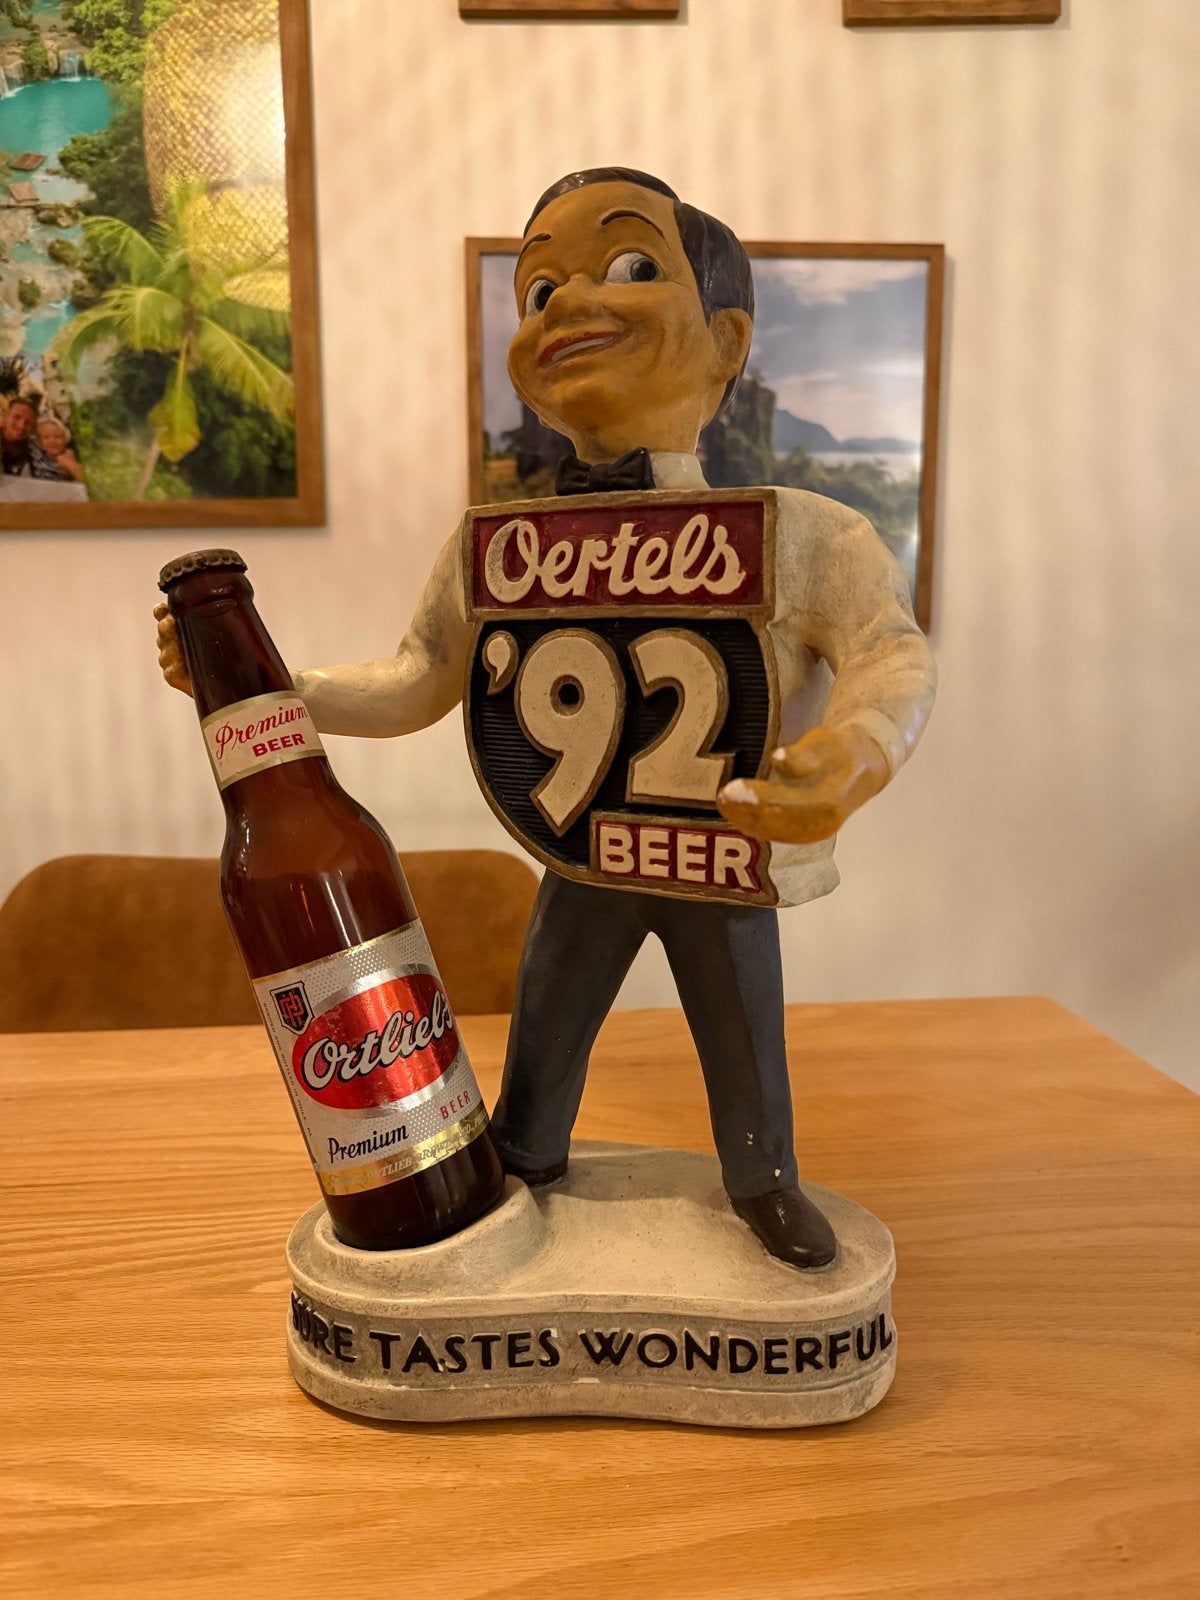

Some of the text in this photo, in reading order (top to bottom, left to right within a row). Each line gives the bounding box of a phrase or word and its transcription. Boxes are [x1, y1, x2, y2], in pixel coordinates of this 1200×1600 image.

[215, 706, 308, 760] Premium
[252, 733, 306, 758] BEER
[482, 628, 735, 837] '92
[599, 825, 753, 889] BEER
[440, 1090, 471, 1120] BEER
[328, 1125, 409, 1164] Premium
[370, 1329, 560, 1373] TASTES
[577, 1313, 892, 1375] WONDERFUL
